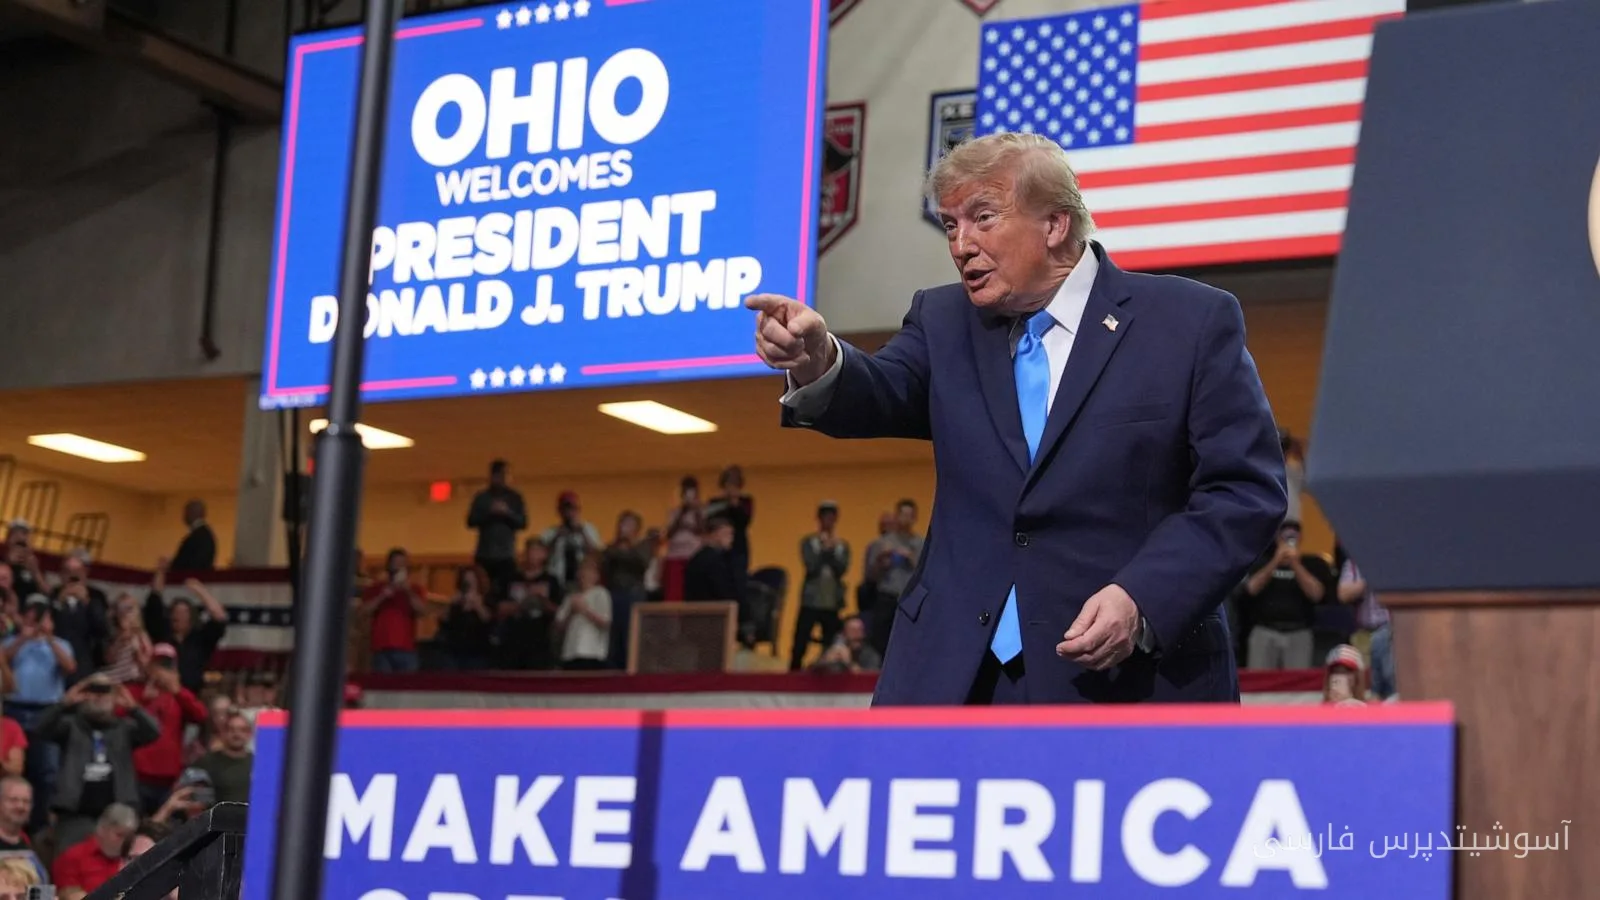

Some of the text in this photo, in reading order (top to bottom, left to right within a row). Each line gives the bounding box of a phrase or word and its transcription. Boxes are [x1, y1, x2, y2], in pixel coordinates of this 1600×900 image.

[411, 48, 669, 167] OHIO
[436, 149, 634, 206] WELCOMES
[368, 190, 717, 285] PRESIDENT
[521, 274, 564, 325] J.
[575, 256, 763, 320] TRUMP
[324, 773, 1328, 888] MAKE AMERICA
